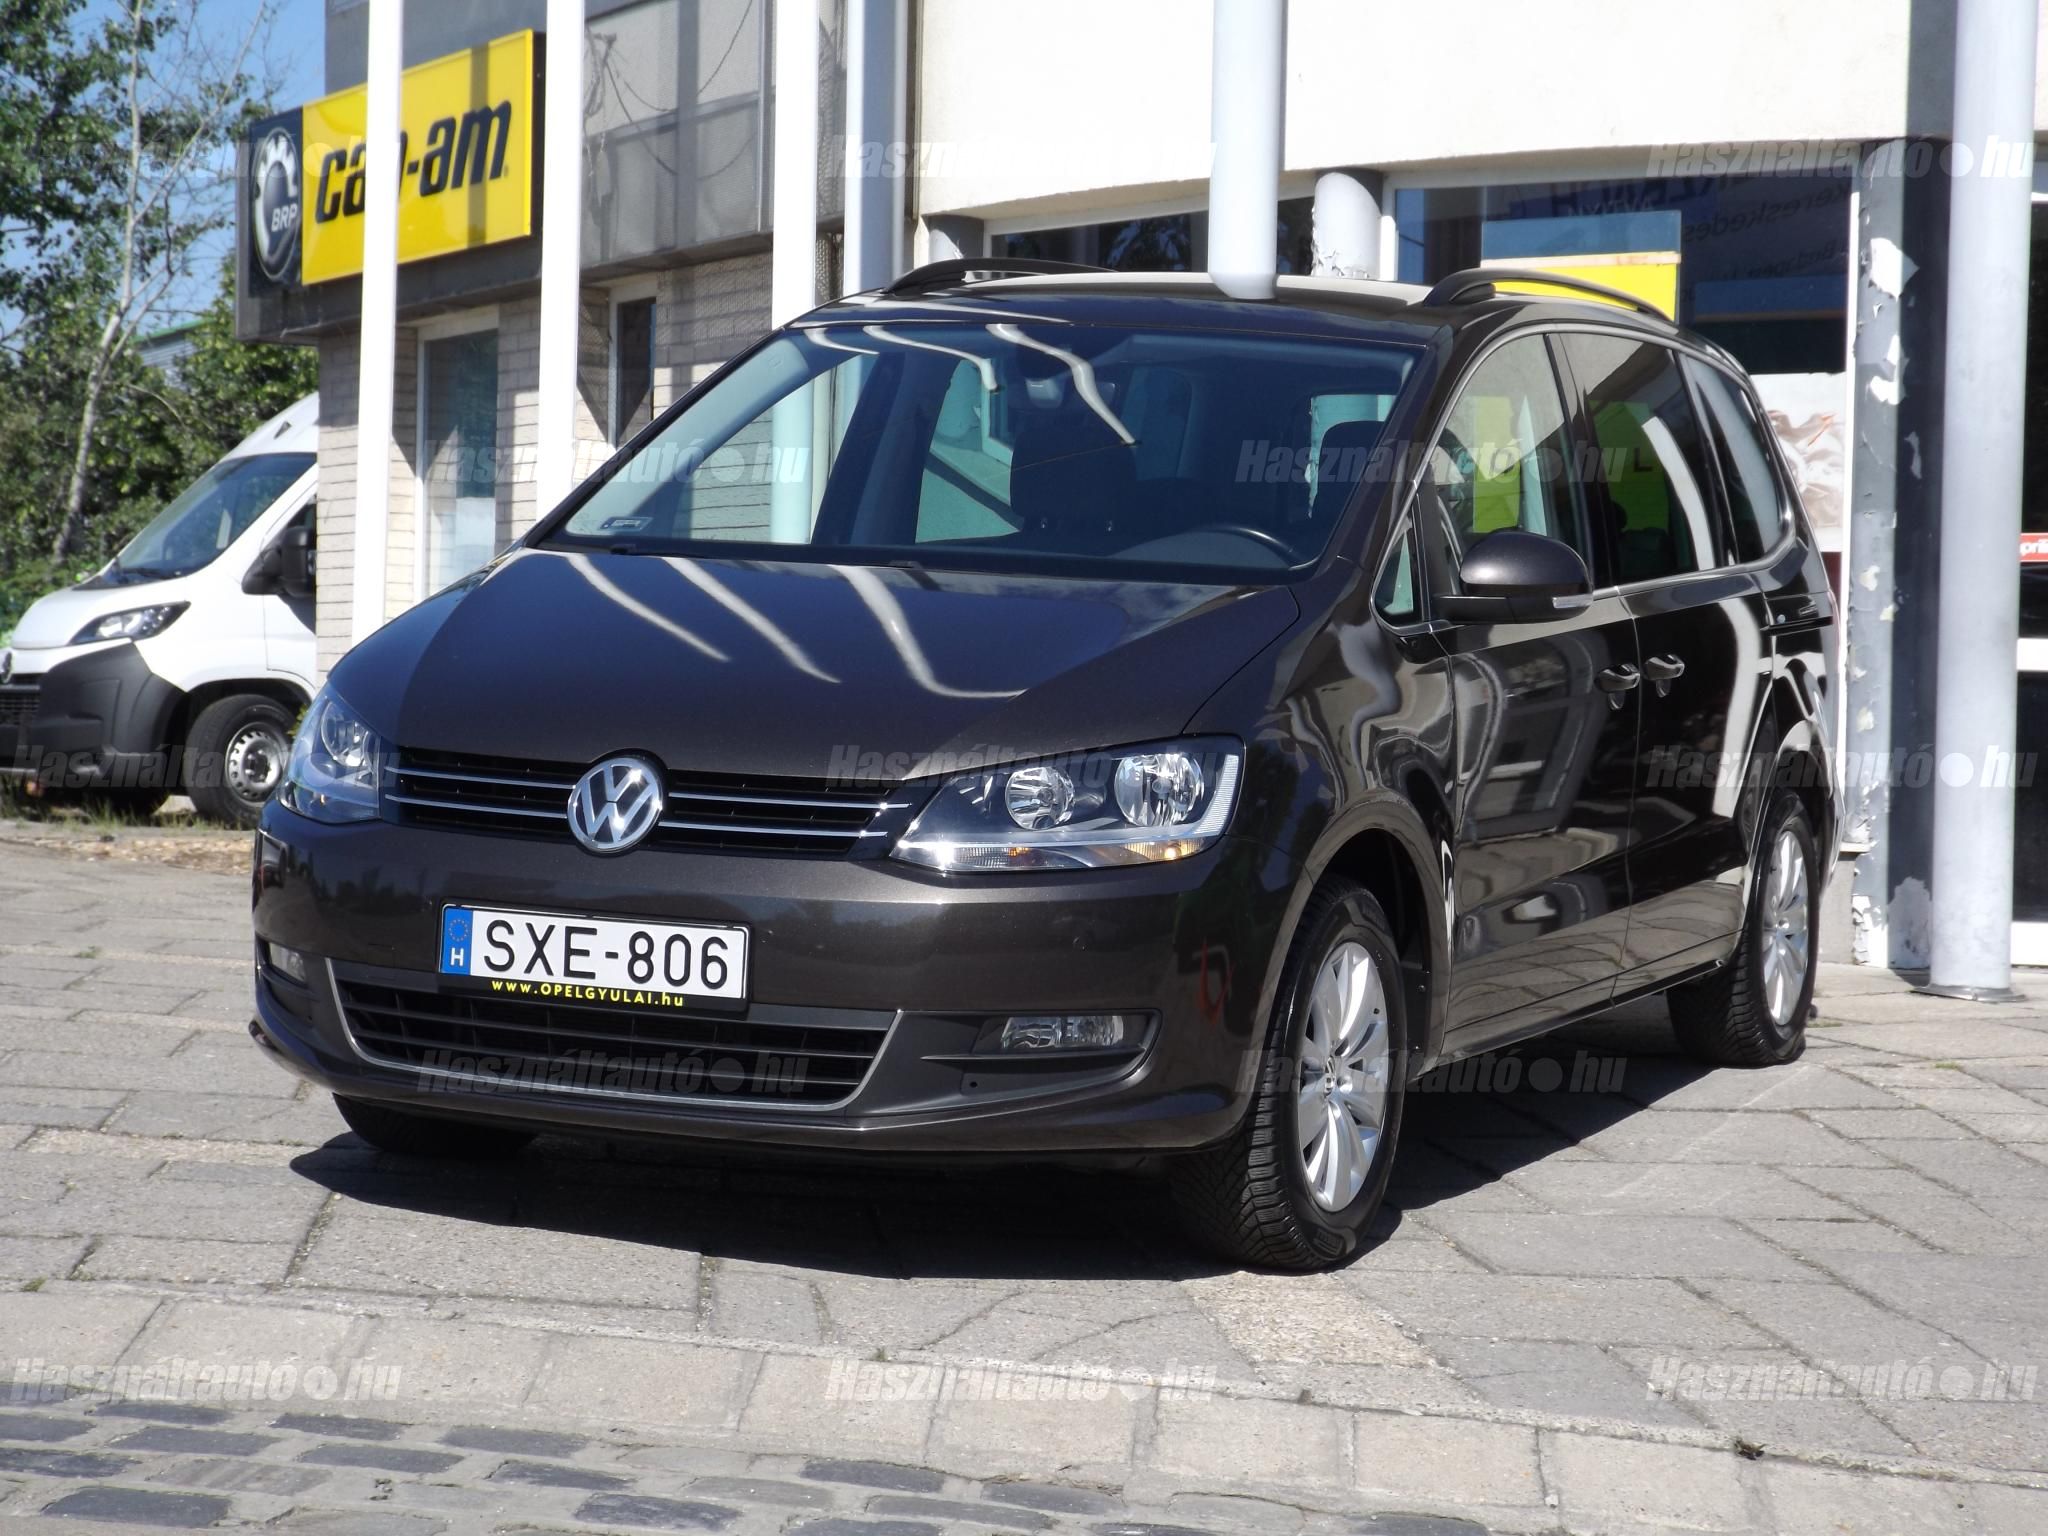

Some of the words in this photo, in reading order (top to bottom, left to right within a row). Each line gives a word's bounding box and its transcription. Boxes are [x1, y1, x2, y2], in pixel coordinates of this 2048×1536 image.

[315, 100, 512, 224] ca-am
[271, 203, 298, 232] BRP
[450, 947, 464, 967] H
[483, 919, 729, 990] SXE-806
[491, 980, 684, 1007] www.OPELGYULAI.hu
